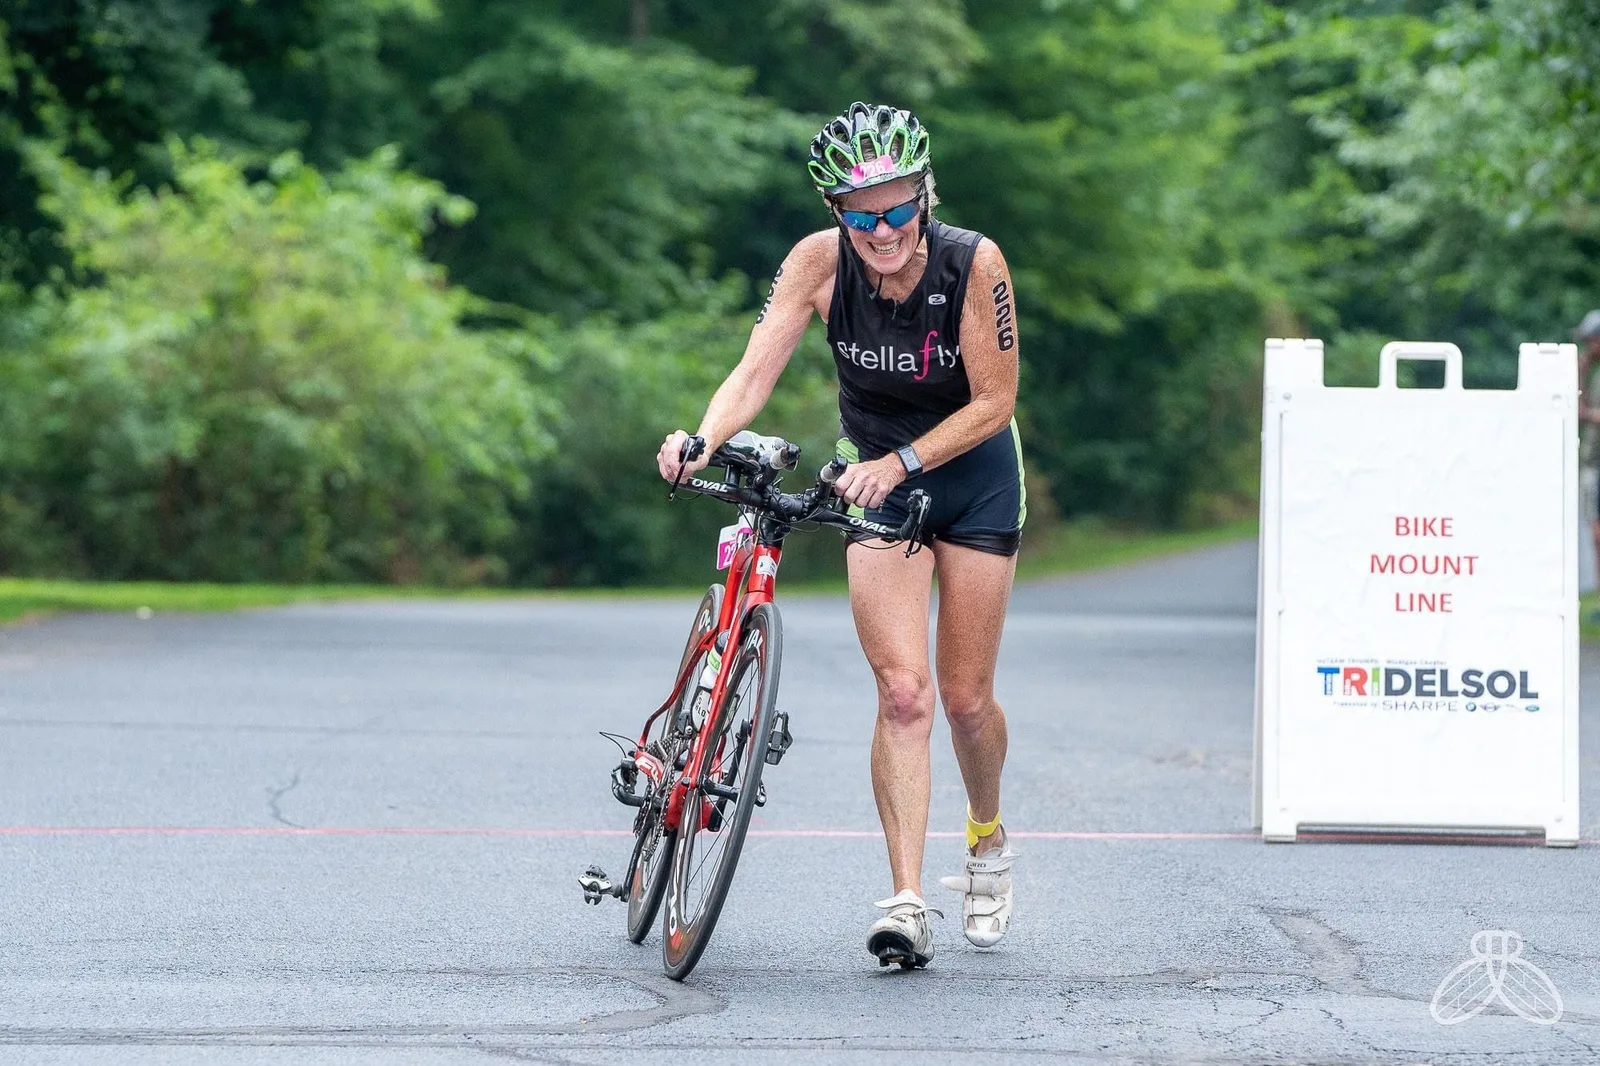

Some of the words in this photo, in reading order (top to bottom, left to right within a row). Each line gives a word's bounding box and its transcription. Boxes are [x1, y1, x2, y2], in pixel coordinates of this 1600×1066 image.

[992, 280, 1014, 351] 226
[837, 330, 961, 381] stellafly
[691, 479, 729, 493] OVAL
[849, 517, 887, 534] OVAL
[1395, 516, 1454, 537] BIKE
[1370, 554, 1480, 575] MOUNT
[1395, 592, 1453, 613] LINE
[1382, 700, 1459, 711] SHARPE
